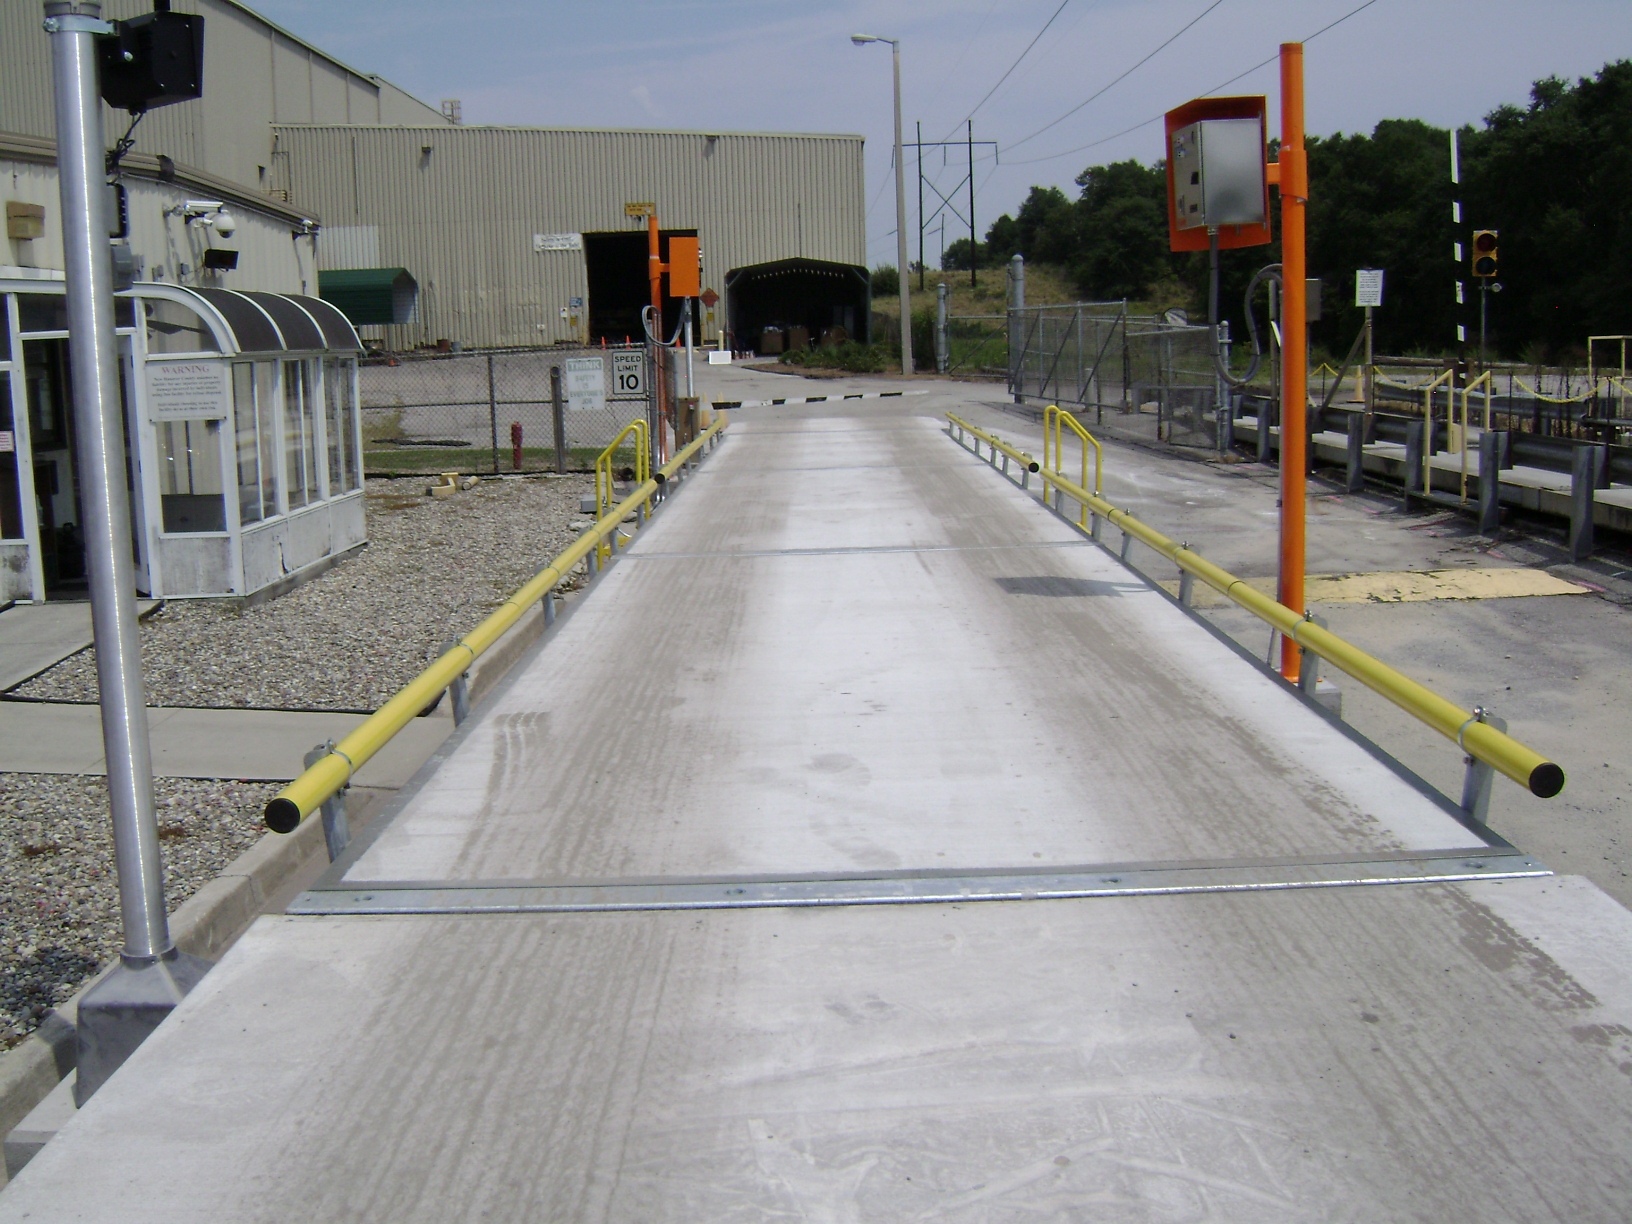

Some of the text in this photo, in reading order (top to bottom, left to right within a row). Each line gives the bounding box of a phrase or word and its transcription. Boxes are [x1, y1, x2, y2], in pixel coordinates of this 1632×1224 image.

[162, 365, 210, 374] WARNING
[569, 361, 600, 370] THINK
[619, 374, 638, 390] 10
